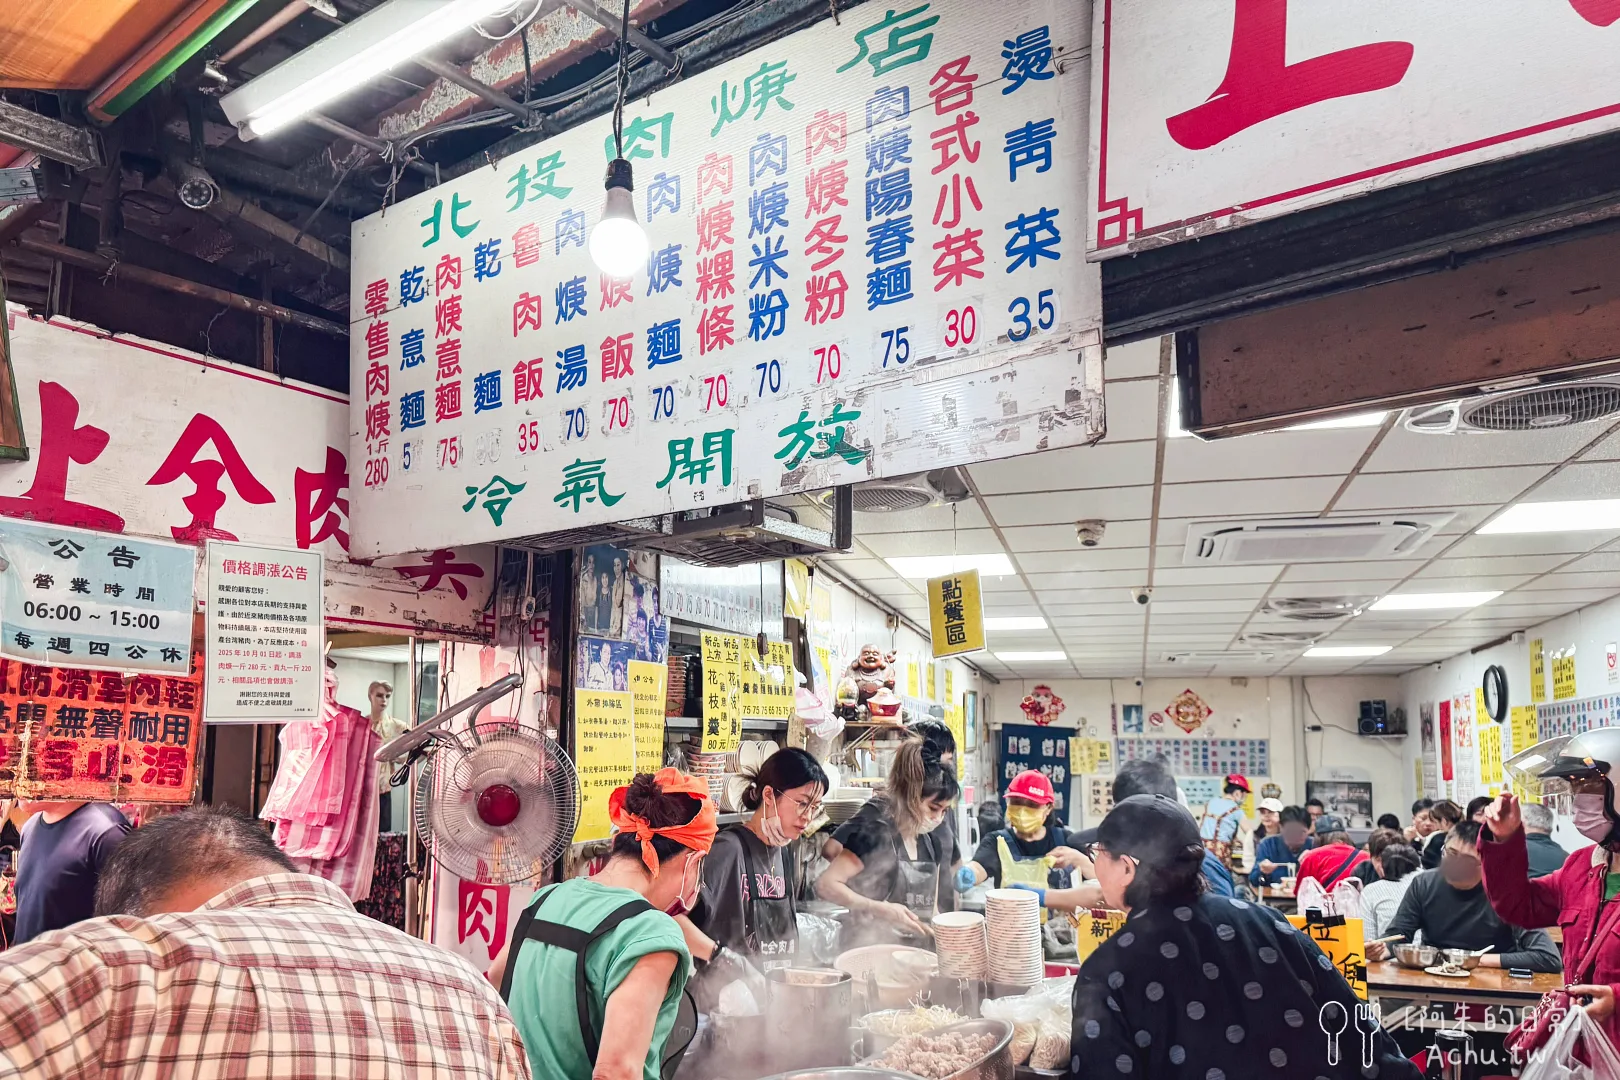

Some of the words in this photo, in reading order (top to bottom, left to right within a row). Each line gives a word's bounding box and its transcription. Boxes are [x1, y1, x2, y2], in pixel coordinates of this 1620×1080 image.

[1001, 24, 1061, 274] 燙青菜
[929, 54, 985, 293] 各式小菜
[804, 108, 848, 326] 肉焿冬粉
[748, 132, 789, 342] 肉焿米粉
[646, 172, 683, 370] 肉焿麵
[511, 221, 544, 404] 魯肉飯
[555, 208, 587, 394] 肉焿湯
[1007, 288, 1055, 342] 35
[435, 254, 462, 424] 肉焿意麵
[945, 304, 976, 347] 30
[364, 278, 391, 442] 零售肉焿
[400, 265, 426, 432] 乾意麵
[814, 343, 841, 384] 70
[881, 325, 910, 368] 75
[704, 373, 728, 411] 70
[756, 359, 781, 399] 70
[608, 397, 629, 429] 70
[653, 385, 674, 421] 70
[518, 420, 539, 453] 35
[565, 407, 585, 440] 70
[440, 436, 458, 467] 75
[462, 403, 873, 527] 冷氣開放
[365, 457, 389, 487] 280
[48, 539, 141, 569] 公告
[222, 559, 308, 580] 價格調漲公告
[33, 573, 155, 602] 營業時間
[24, 601, 81, 621] 06:00
[110, 610, 160, 629] 15:00
[942, 577, 967, 645] 點餐區
[14, 631, 183, 663] 每週四公休
[705, 635, 720, 648] 新品
[706, 649, 722, 660] 上市
[706, 668, 720, 736] 花枝羹
[743, 705, 751, 715] 75
[752, 705, 760, 715] 75
[708, 740, 717, 750] 80
[718, 739, 726, 750] 元
